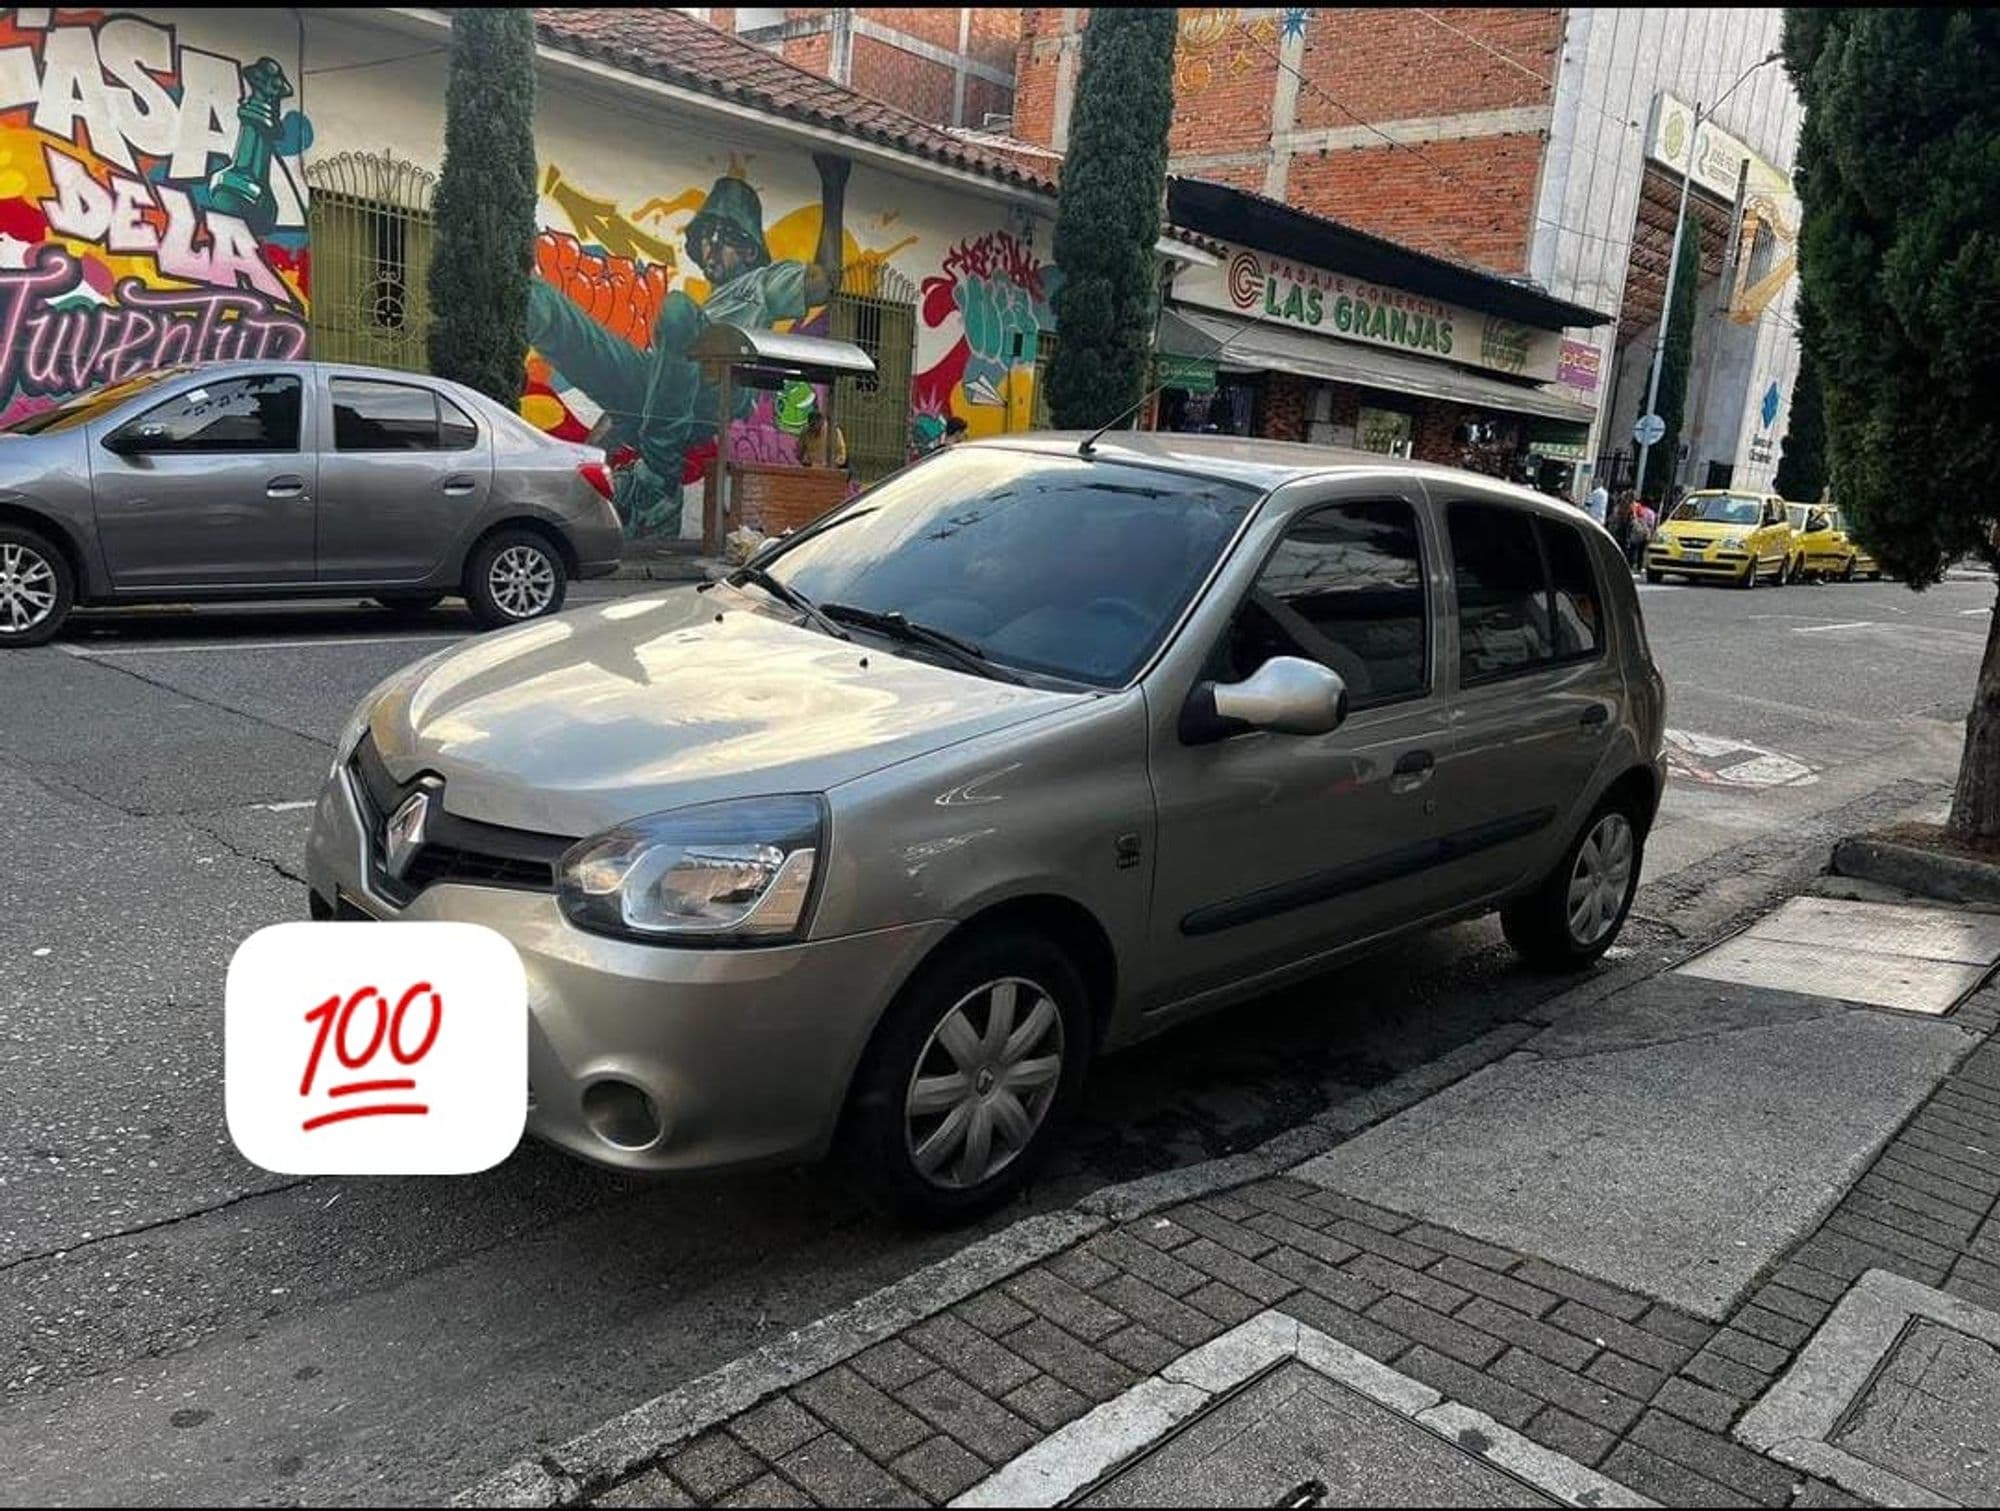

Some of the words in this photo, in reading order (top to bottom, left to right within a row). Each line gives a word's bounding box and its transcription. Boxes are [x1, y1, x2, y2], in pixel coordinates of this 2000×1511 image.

[1264, 277, 1324, 325] LAS
[1333, 295, 1454, 354] GRANJAS
[1269, 261, 1345, 293] PASAJE
[1355, 283, 1454, 321] COMERCIAL
